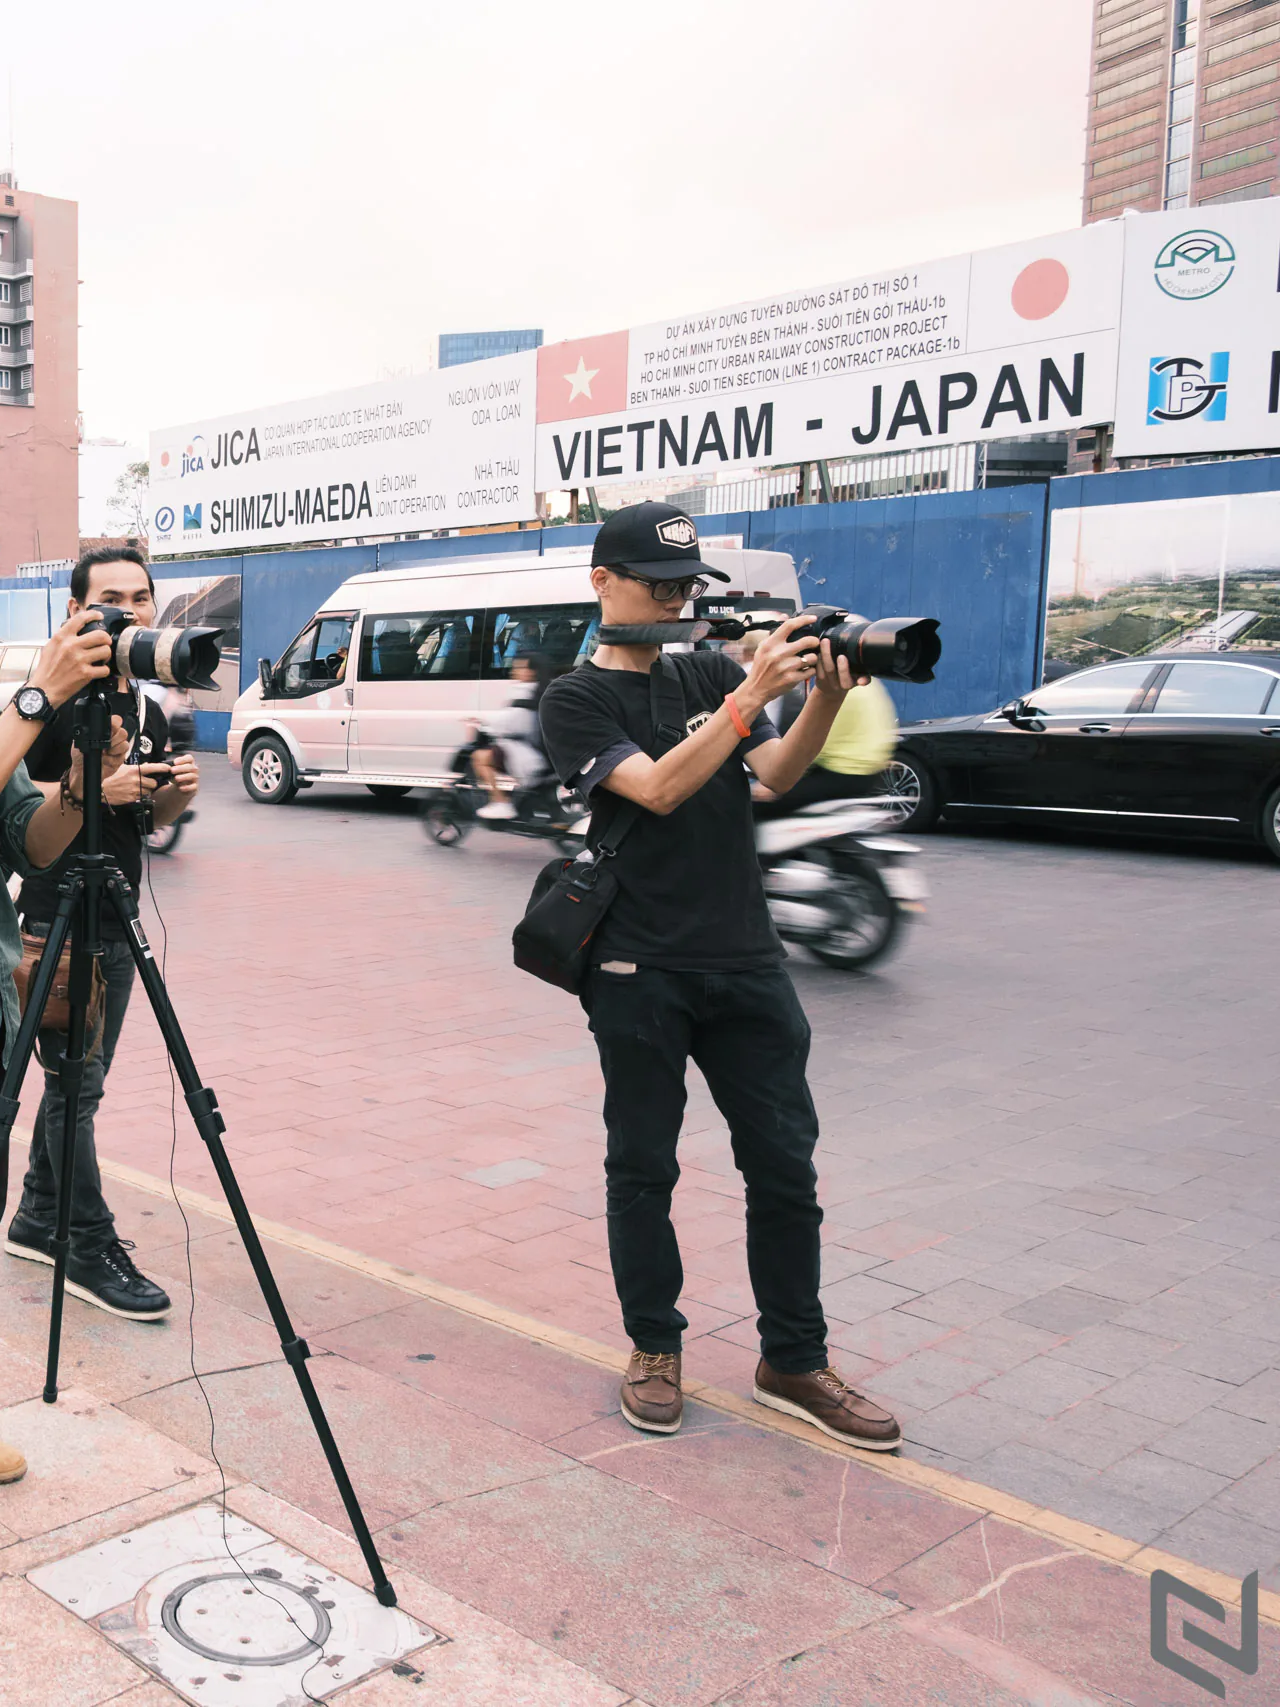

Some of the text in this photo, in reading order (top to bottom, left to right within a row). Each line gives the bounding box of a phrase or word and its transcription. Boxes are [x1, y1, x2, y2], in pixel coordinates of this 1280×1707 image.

[912, 274, 918, 288] 1
[1177, 267, 1211, 277] METRO
[640, 315, 948, 384] HO CHI MINH CITY URBAN RAILWAY CONSTRUCTION PROJECT
[644, 352, 655, 365] TP
[690, 340, 713, 356] MINH
[630, 390, 648, 404] BEN
[651, 384, 681, 401] THANH
[688, 378, 711, 395] SUOI
[713, 375, 734, 391] TIEN
[737, 367, 780, 387] SECTION
[782, 361, 808, 382] (LINE
[811, 359, 820, 377] 1)
[823, 348, 883, 372] CONTRACT
[886, 336, 960, 361] PACKAGE-1b
[503, 378, 521, 397] VAY
[471, 402, 521, 426] ODA LOAN
[552, 352, 1085, 482] VIETNAM - JAPAN
[210, 427, 261, 469] JICA
[264, 418, 432, 460] JAPAN INTERNATIONAL COOPERATION AGENCY
[394, 473, 417, 492] DANH
[210, 480, 373, 535] SHIMIZU-MAEDA
[375, 494, 447, 518] JOINT OPERATION
[457, 485, 519, 509] CONTRACTOR
[708, 606, 719, 614] DU
